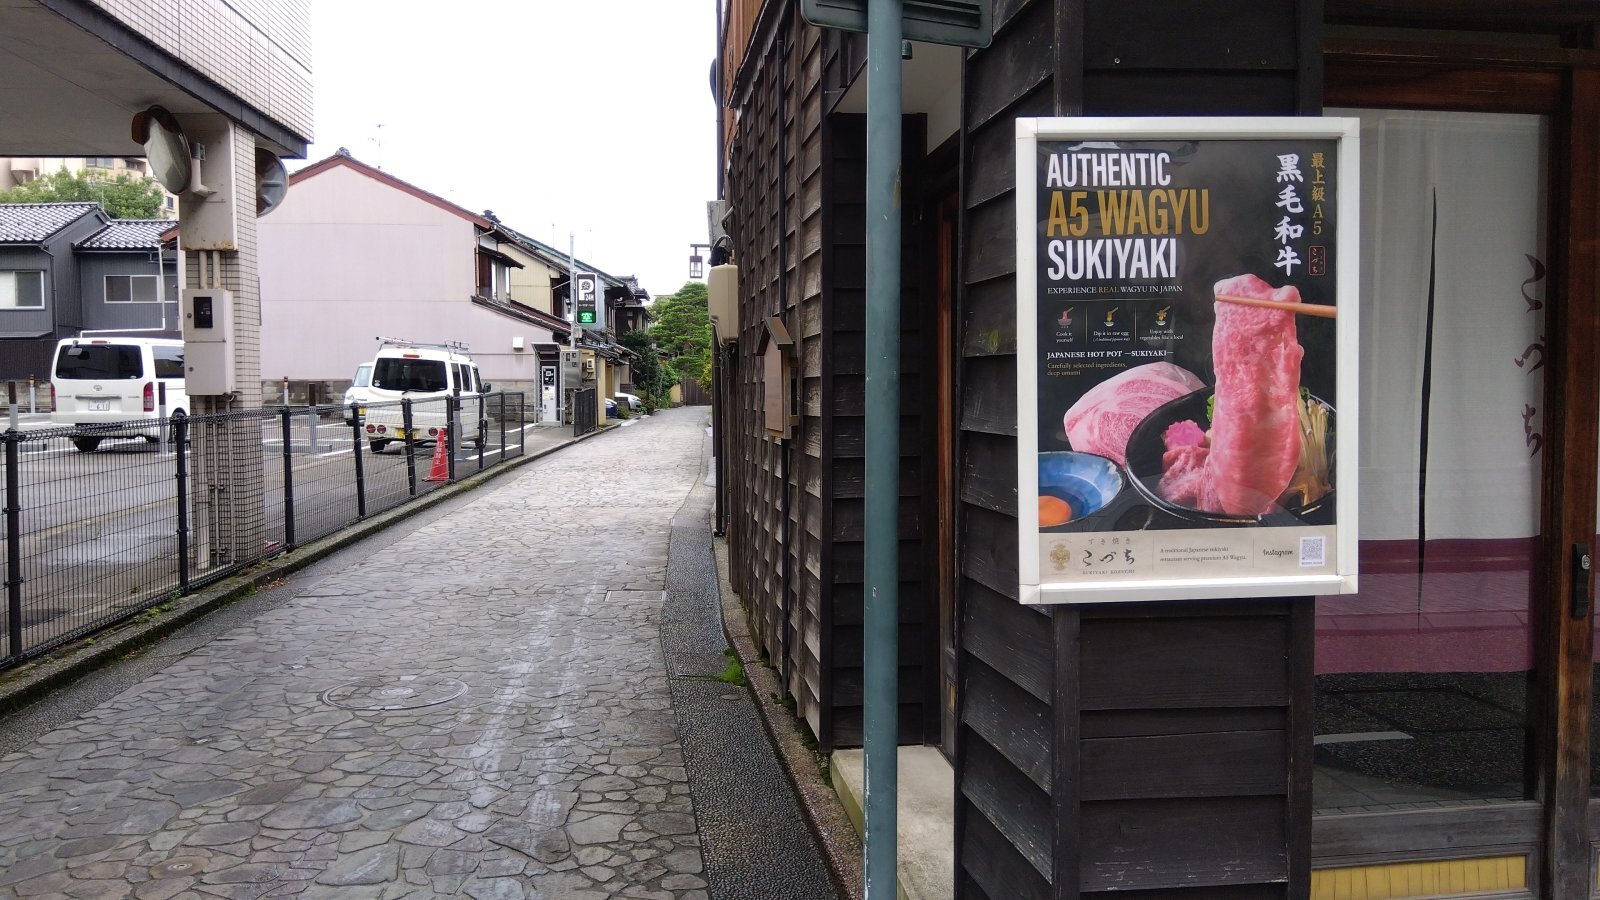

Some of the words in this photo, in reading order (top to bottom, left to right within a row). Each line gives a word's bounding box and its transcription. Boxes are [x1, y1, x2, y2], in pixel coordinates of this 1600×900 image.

[1047, 153, 1171, 187] AUTHENTIC
[1311, 152, 1326, 235] 最上級A5
[1047, 190, 1089, 237] A5
[1097, 189, 1209, 236] WAGYU
[1274, 153, 1304, 277] 黒毛和牛
[1047, 238, 1177, 280] SUKIYAKI
[1159, 285, 1183, 294] JAPAN
[1047, 352, 1086, 360] JAPANESE
[1083, 549, 1135, 567] こづち
[1263, 549, 1294, 557] Instagram
